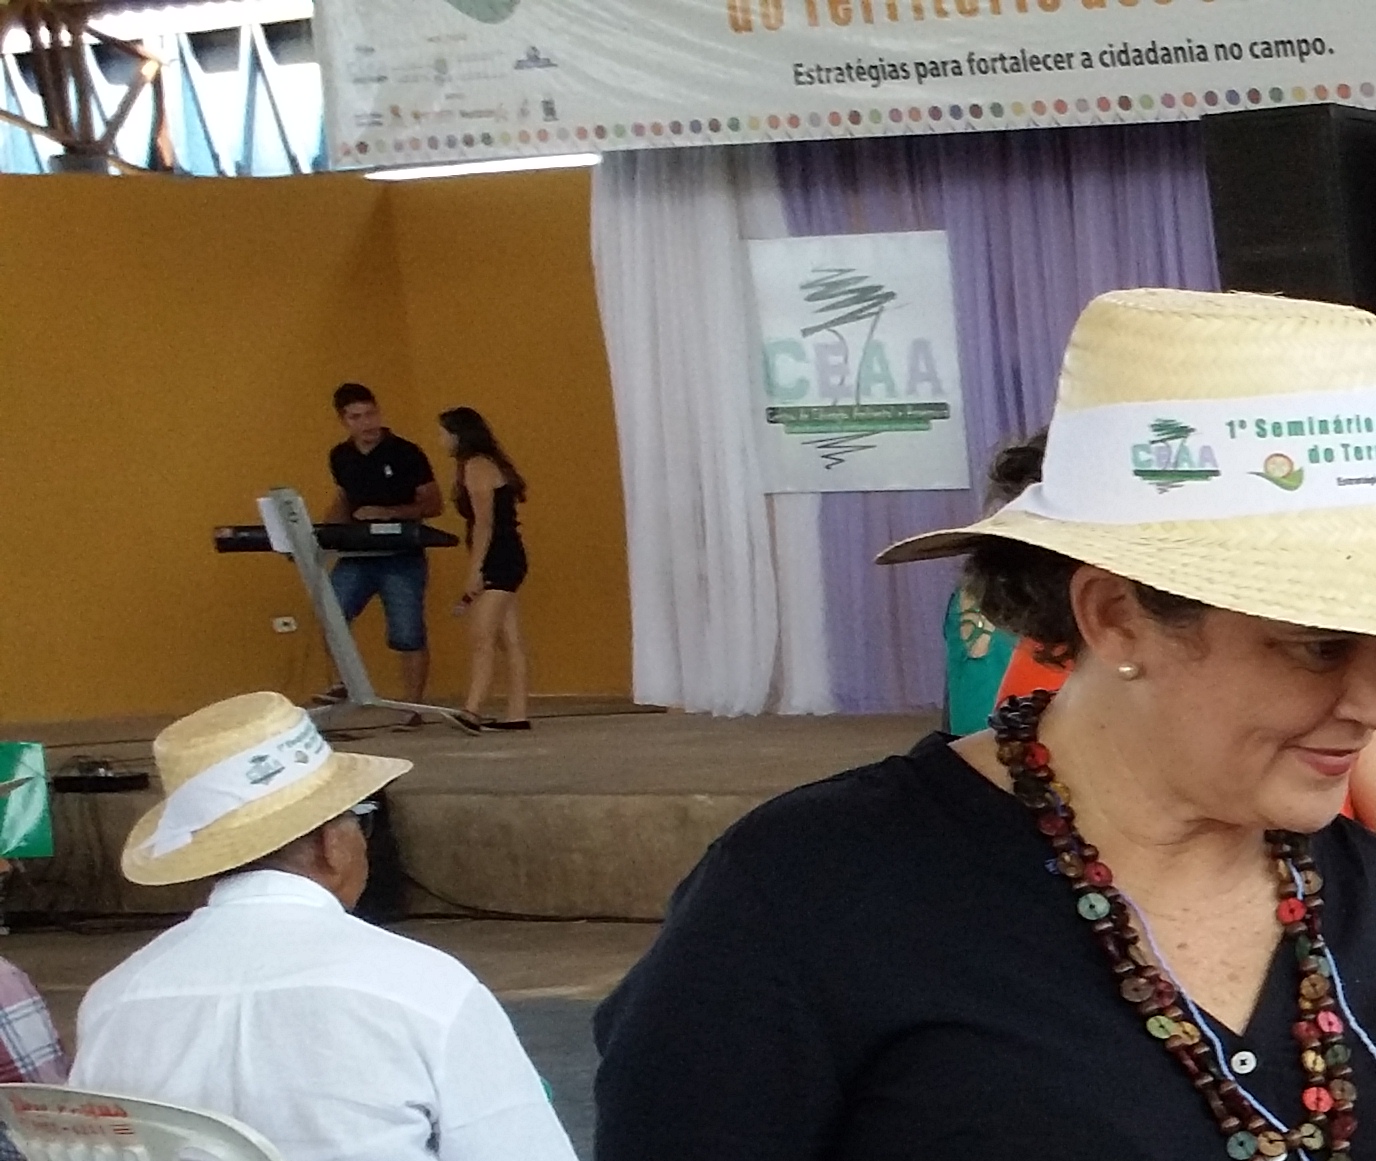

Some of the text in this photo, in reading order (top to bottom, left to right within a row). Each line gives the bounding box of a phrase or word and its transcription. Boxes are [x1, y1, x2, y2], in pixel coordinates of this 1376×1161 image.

[793, 36, 1334, 88] Estratégias para fortalecer a cidadania no campo.
[763, 336, 946, 401] CEAA
[1225, 418, 1247, 439] 1º
[1254, 415, 1374, 439] Seminário
[1131, 443, 1219, 469] CEAA
